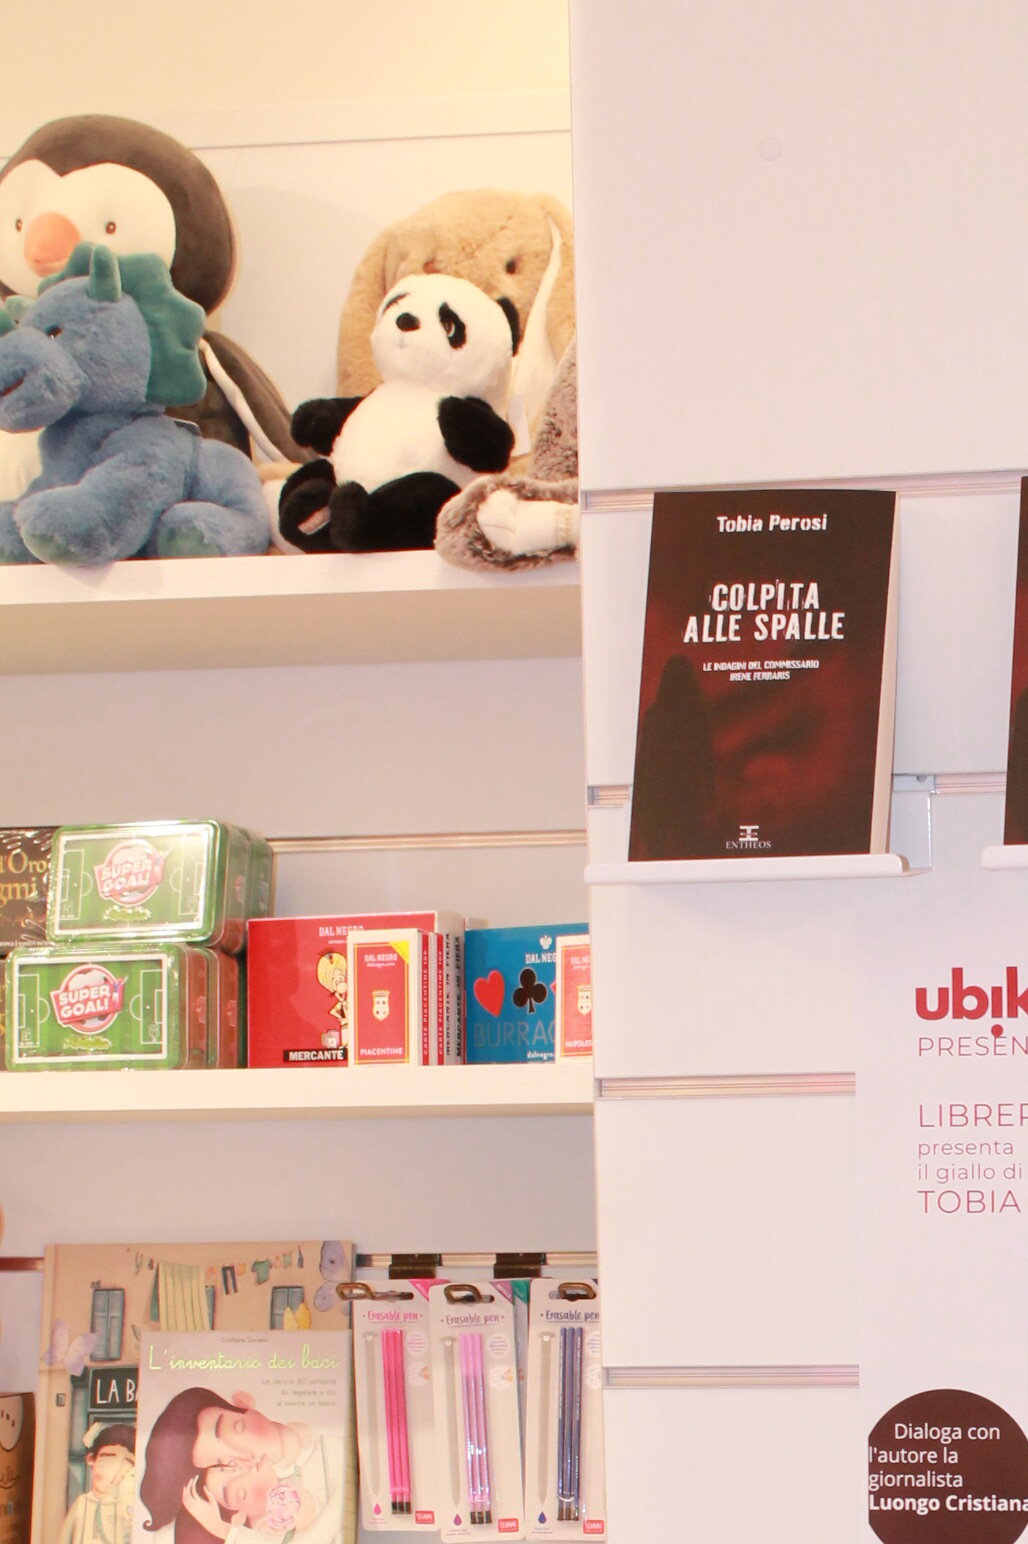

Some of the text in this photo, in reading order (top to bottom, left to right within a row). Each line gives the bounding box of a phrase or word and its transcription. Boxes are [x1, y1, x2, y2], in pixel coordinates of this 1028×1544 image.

[717, 514, 827, 532] Tobia Perosi
[712, 583, 819, 611] COLPITA
[684, 612, 844, 642] ALLE SPALLE
[59, 984, 111, 1006] SUPER
[60, 998, 109, 1018] GOAL!
[289, 1050, 344, 1061] MERCANTE
[919, 1141, 1013, 1159] presenta
[919, 1163, 1021, 1184] il giallo di
[918, 1190, 1021, 1213] TOBIA
[368, 1311, 417, 1323] Erasable pen
[546, 1310, 599, 1322] Erasable pen
[149, 1343, 339, 1370] L'inventario dei baci
[895, 1423, 1000, 1444] Dialoga con
[869, 1447, 958, 1463] l'autore la
[869, 1470, 962, 1491] giornalista
[869, 1498, 940, 1515] Luongo
